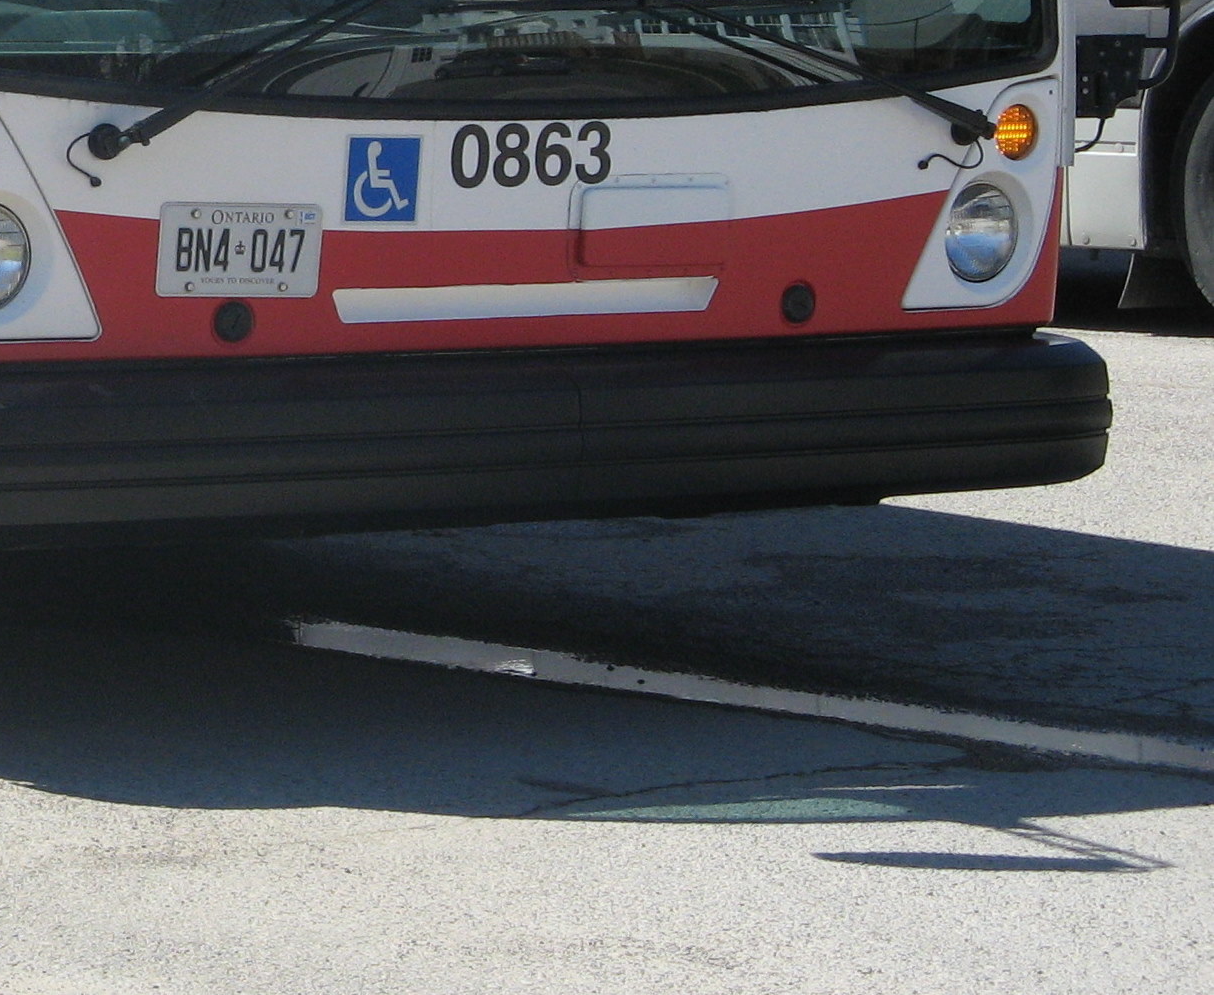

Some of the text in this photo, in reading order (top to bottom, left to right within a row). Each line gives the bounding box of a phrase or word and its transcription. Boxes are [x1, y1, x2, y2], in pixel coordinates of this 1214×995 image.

[451, 120, 611, 189] 0863
[211, 209, 275, 225] ONTARIO
[176, 227, 306, 273] BN4 047
